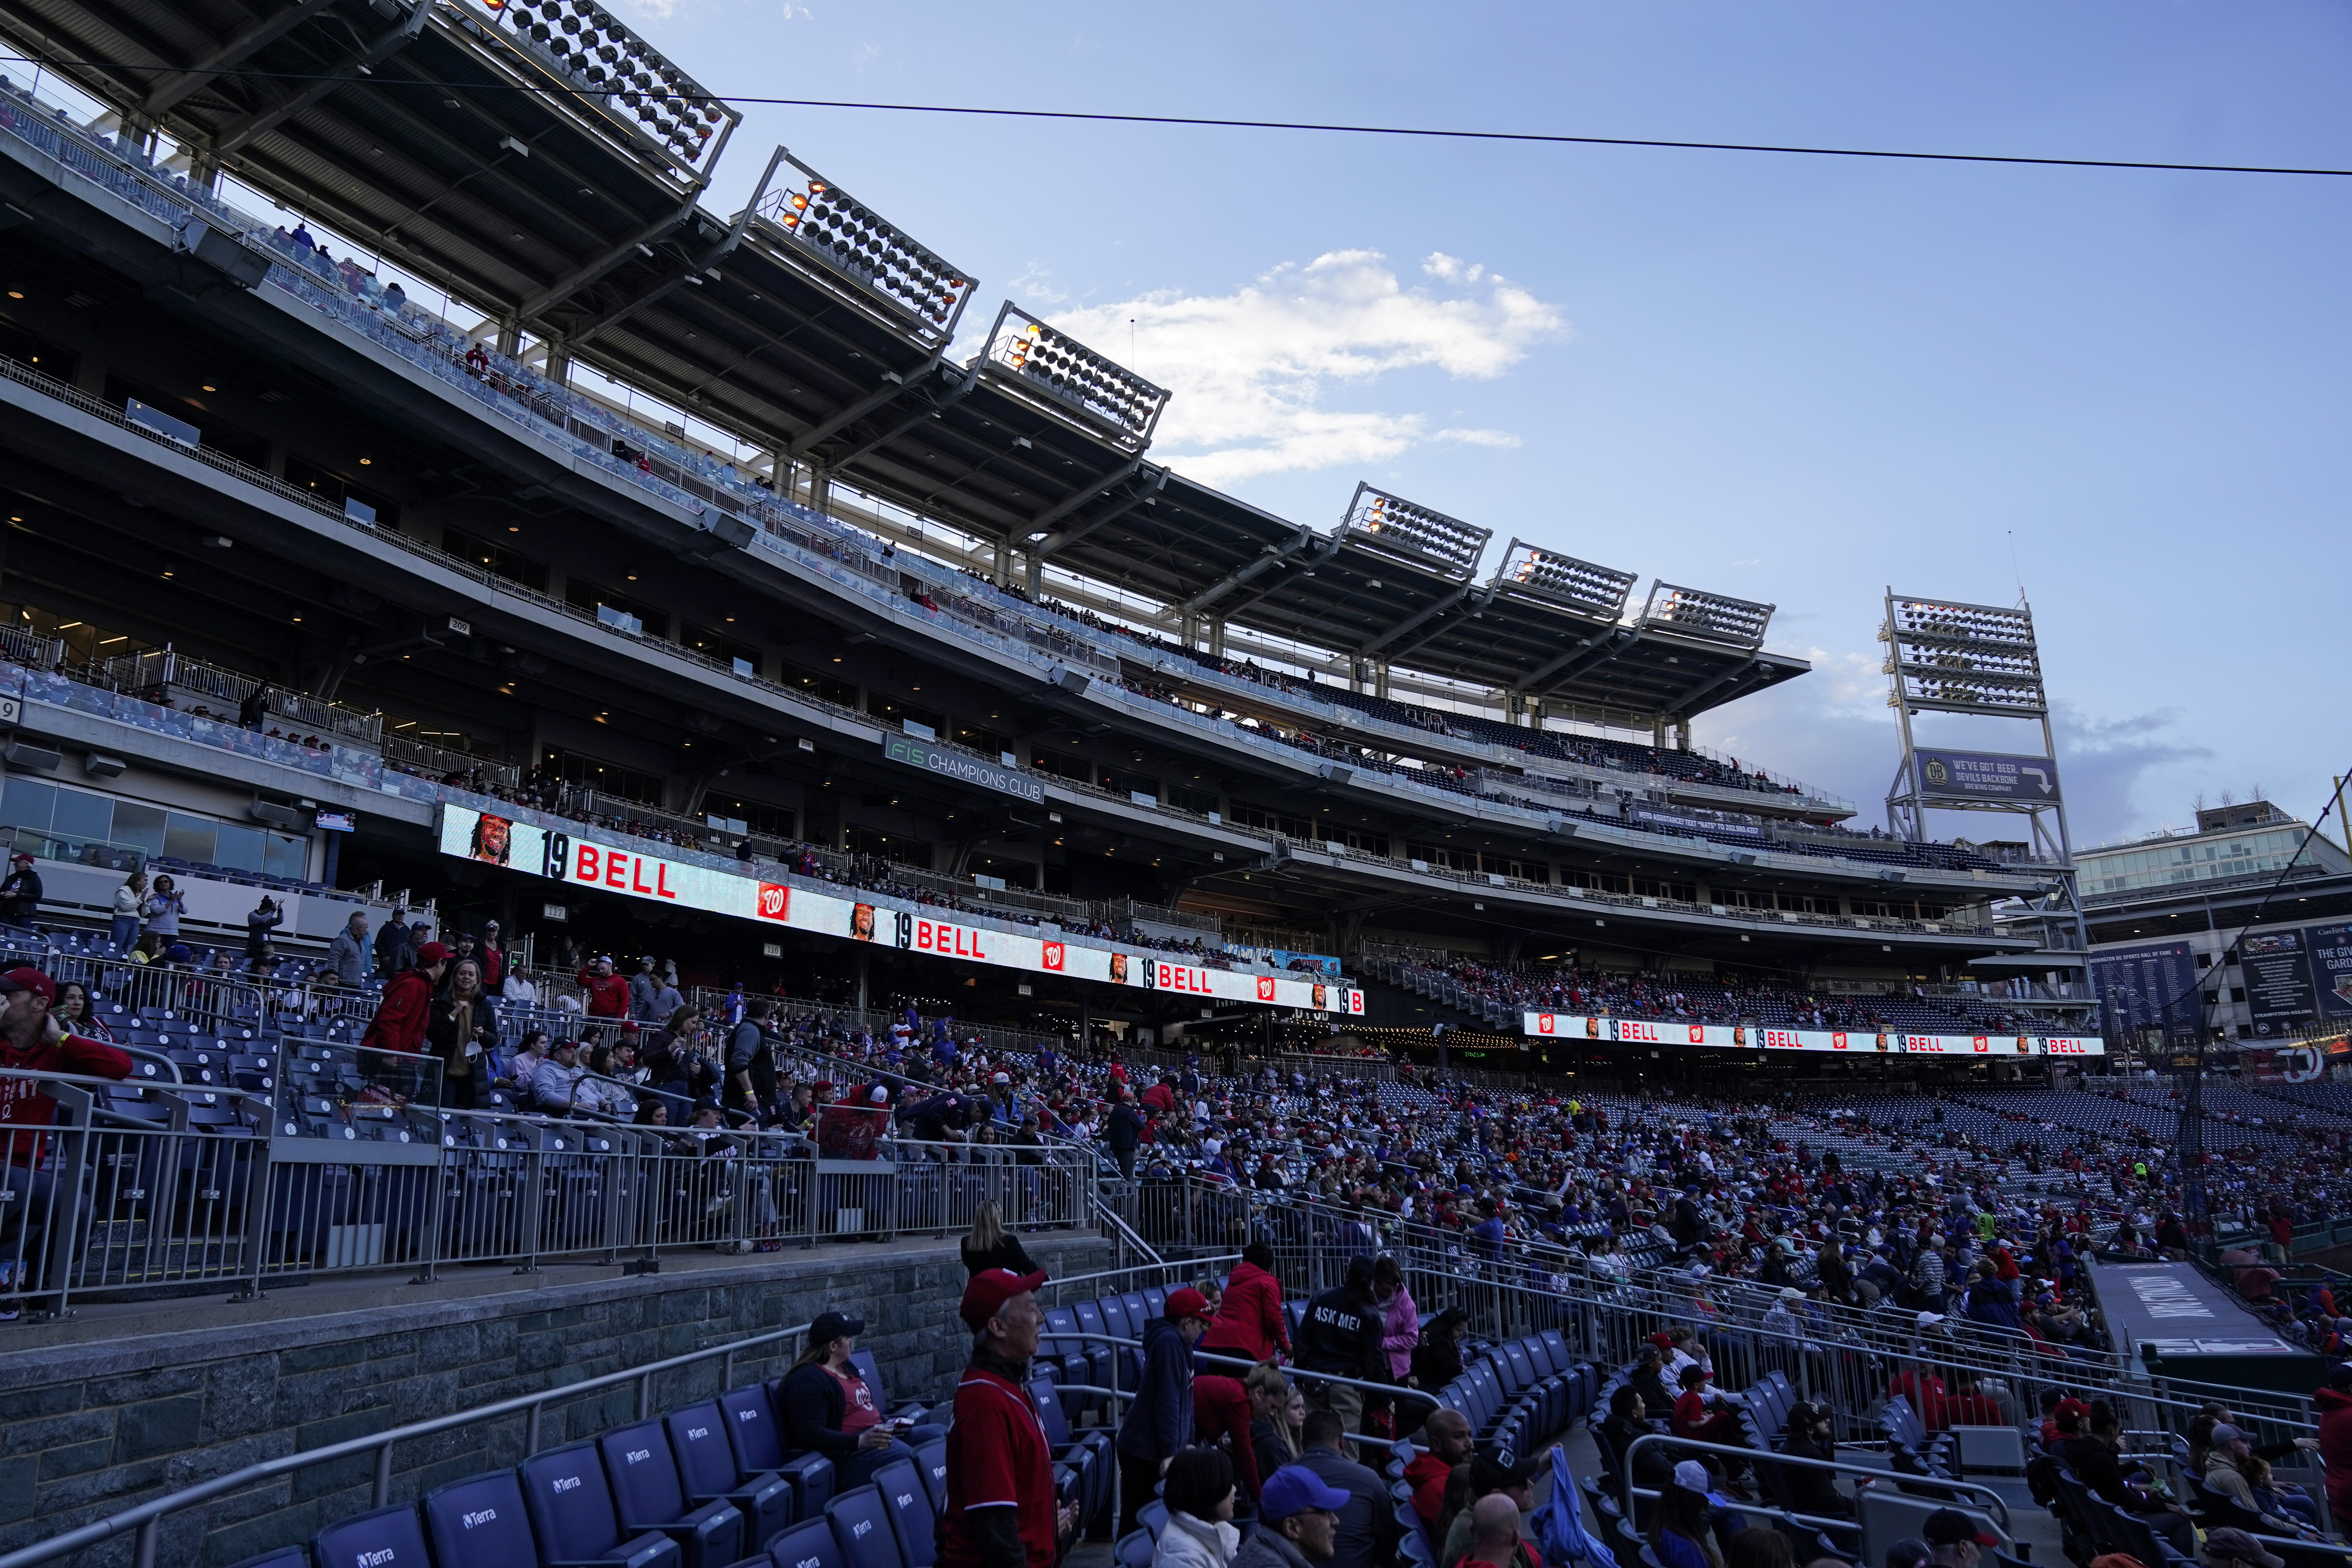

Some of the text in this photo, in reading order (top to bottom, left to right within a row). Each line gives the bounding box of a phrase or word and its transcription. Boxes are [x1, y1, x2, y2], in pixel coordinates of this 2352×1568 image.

[669, 426, 681, 435] 407
[453, 620, 466, 632] 209
[0, 703, 13, 717] 9
[1930, 764, 1944, 779] DB
[1953, 760, 2018, 774] WE'VE GOT BEER.
[929, 754, 1005, 789] CHAMPIONS
[1009, 778, 1040, 800] CLUB
[1956, 772, 2018, 784] DEVILS BACKBONE
[1639, 811, 1652, 820] NEED
[1653, 813, 1684, 825] ASSISTANCE?
[541, 831, 675, 898] 19 BELL
[548, 907, 563, 918] 117
[894, 912, 985, 958] 19 BELL
[768, 946, 779, 955] 116
[2316, 948, 2336, 959] THE
[1142, 958, 1212, 993] 19 BELL
[1338, 987, 1362, 1014] 19 B
[1609, 1019, 1658, 1041] 19 BELL
[1755, 1029, 1802, 1048] 19 BELL
[1896, 1034, 1944, 1053] 19 BELL
[2038, 1038, 2085, 1054] 19 BELL
[1981, 1218, 1985, 1227] 9
[1314, 1306, 1361, 1332] ASK ME!
[743, 1410, 757, 1420] Terra
[691, 1428, 708, 1439] Terra
[631, 1449, 650, 1462] Terra
[559, 1469, 581, 1491] Terra
[900, 1493, 913, 1507] Terra
[470, 1508, 496, 1526] Terra
[857, 1520, 872, 1537] Terra
[365, 1548, 394, 1567] Terra
